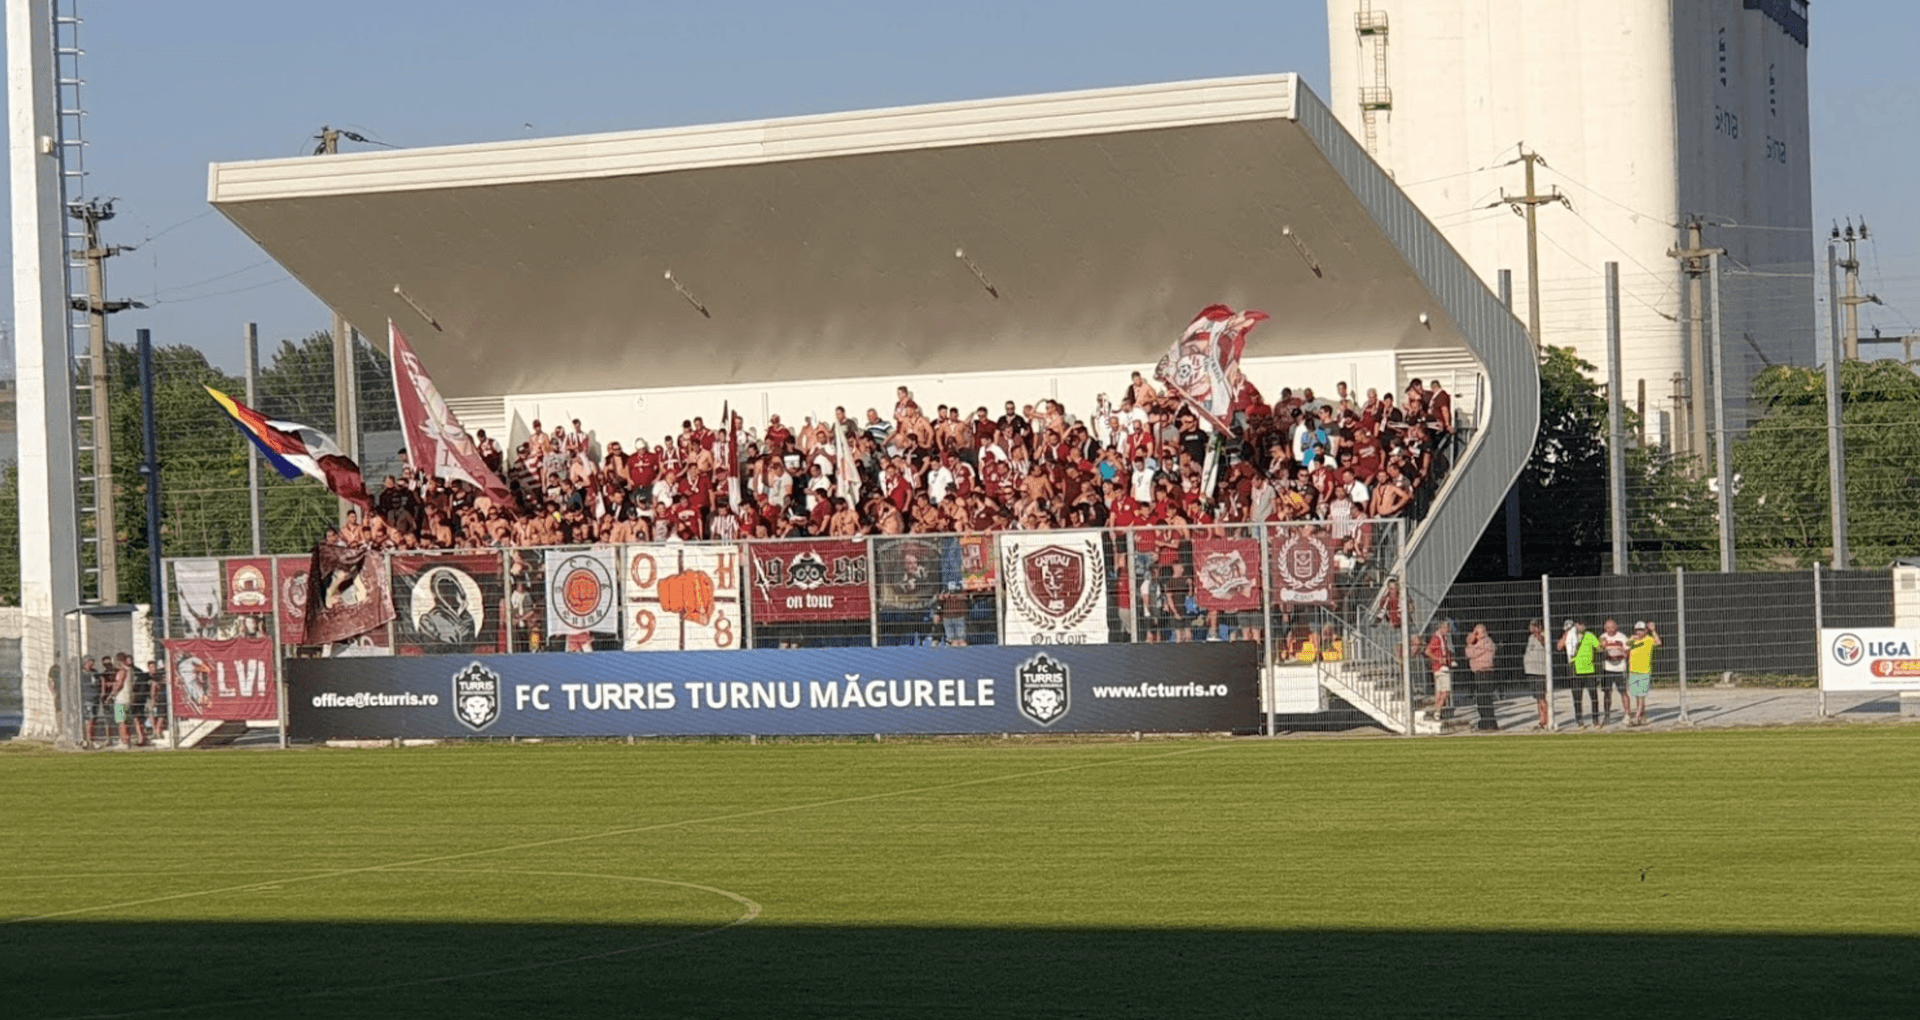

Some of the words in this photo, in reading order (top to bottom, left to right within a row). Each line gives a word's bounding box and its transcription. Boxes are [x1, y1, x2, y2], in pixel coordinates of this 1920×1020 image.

[786, 595, 803, 608] on
[806, 593, 834, 608] tour
[1868, 641, 1911, 657] LIGA
[1037, 664, 1049, 673] FC
[471, 673, 482, 681] FC
[1023, 673, 1064, 683] TURRIS
[459, 681, 494, 691] TURRIS
[515, 684, 550, 711] FC
[561, 682, 676, 710] TURRIS
[685, 681, 801, 709] TURNU
[809, 673, 995, 708] MĂGURELE
[1093, 682, 1228, 698] www.fcturris.ro
[312, 692, 439, 709] office@fcturris.ro
